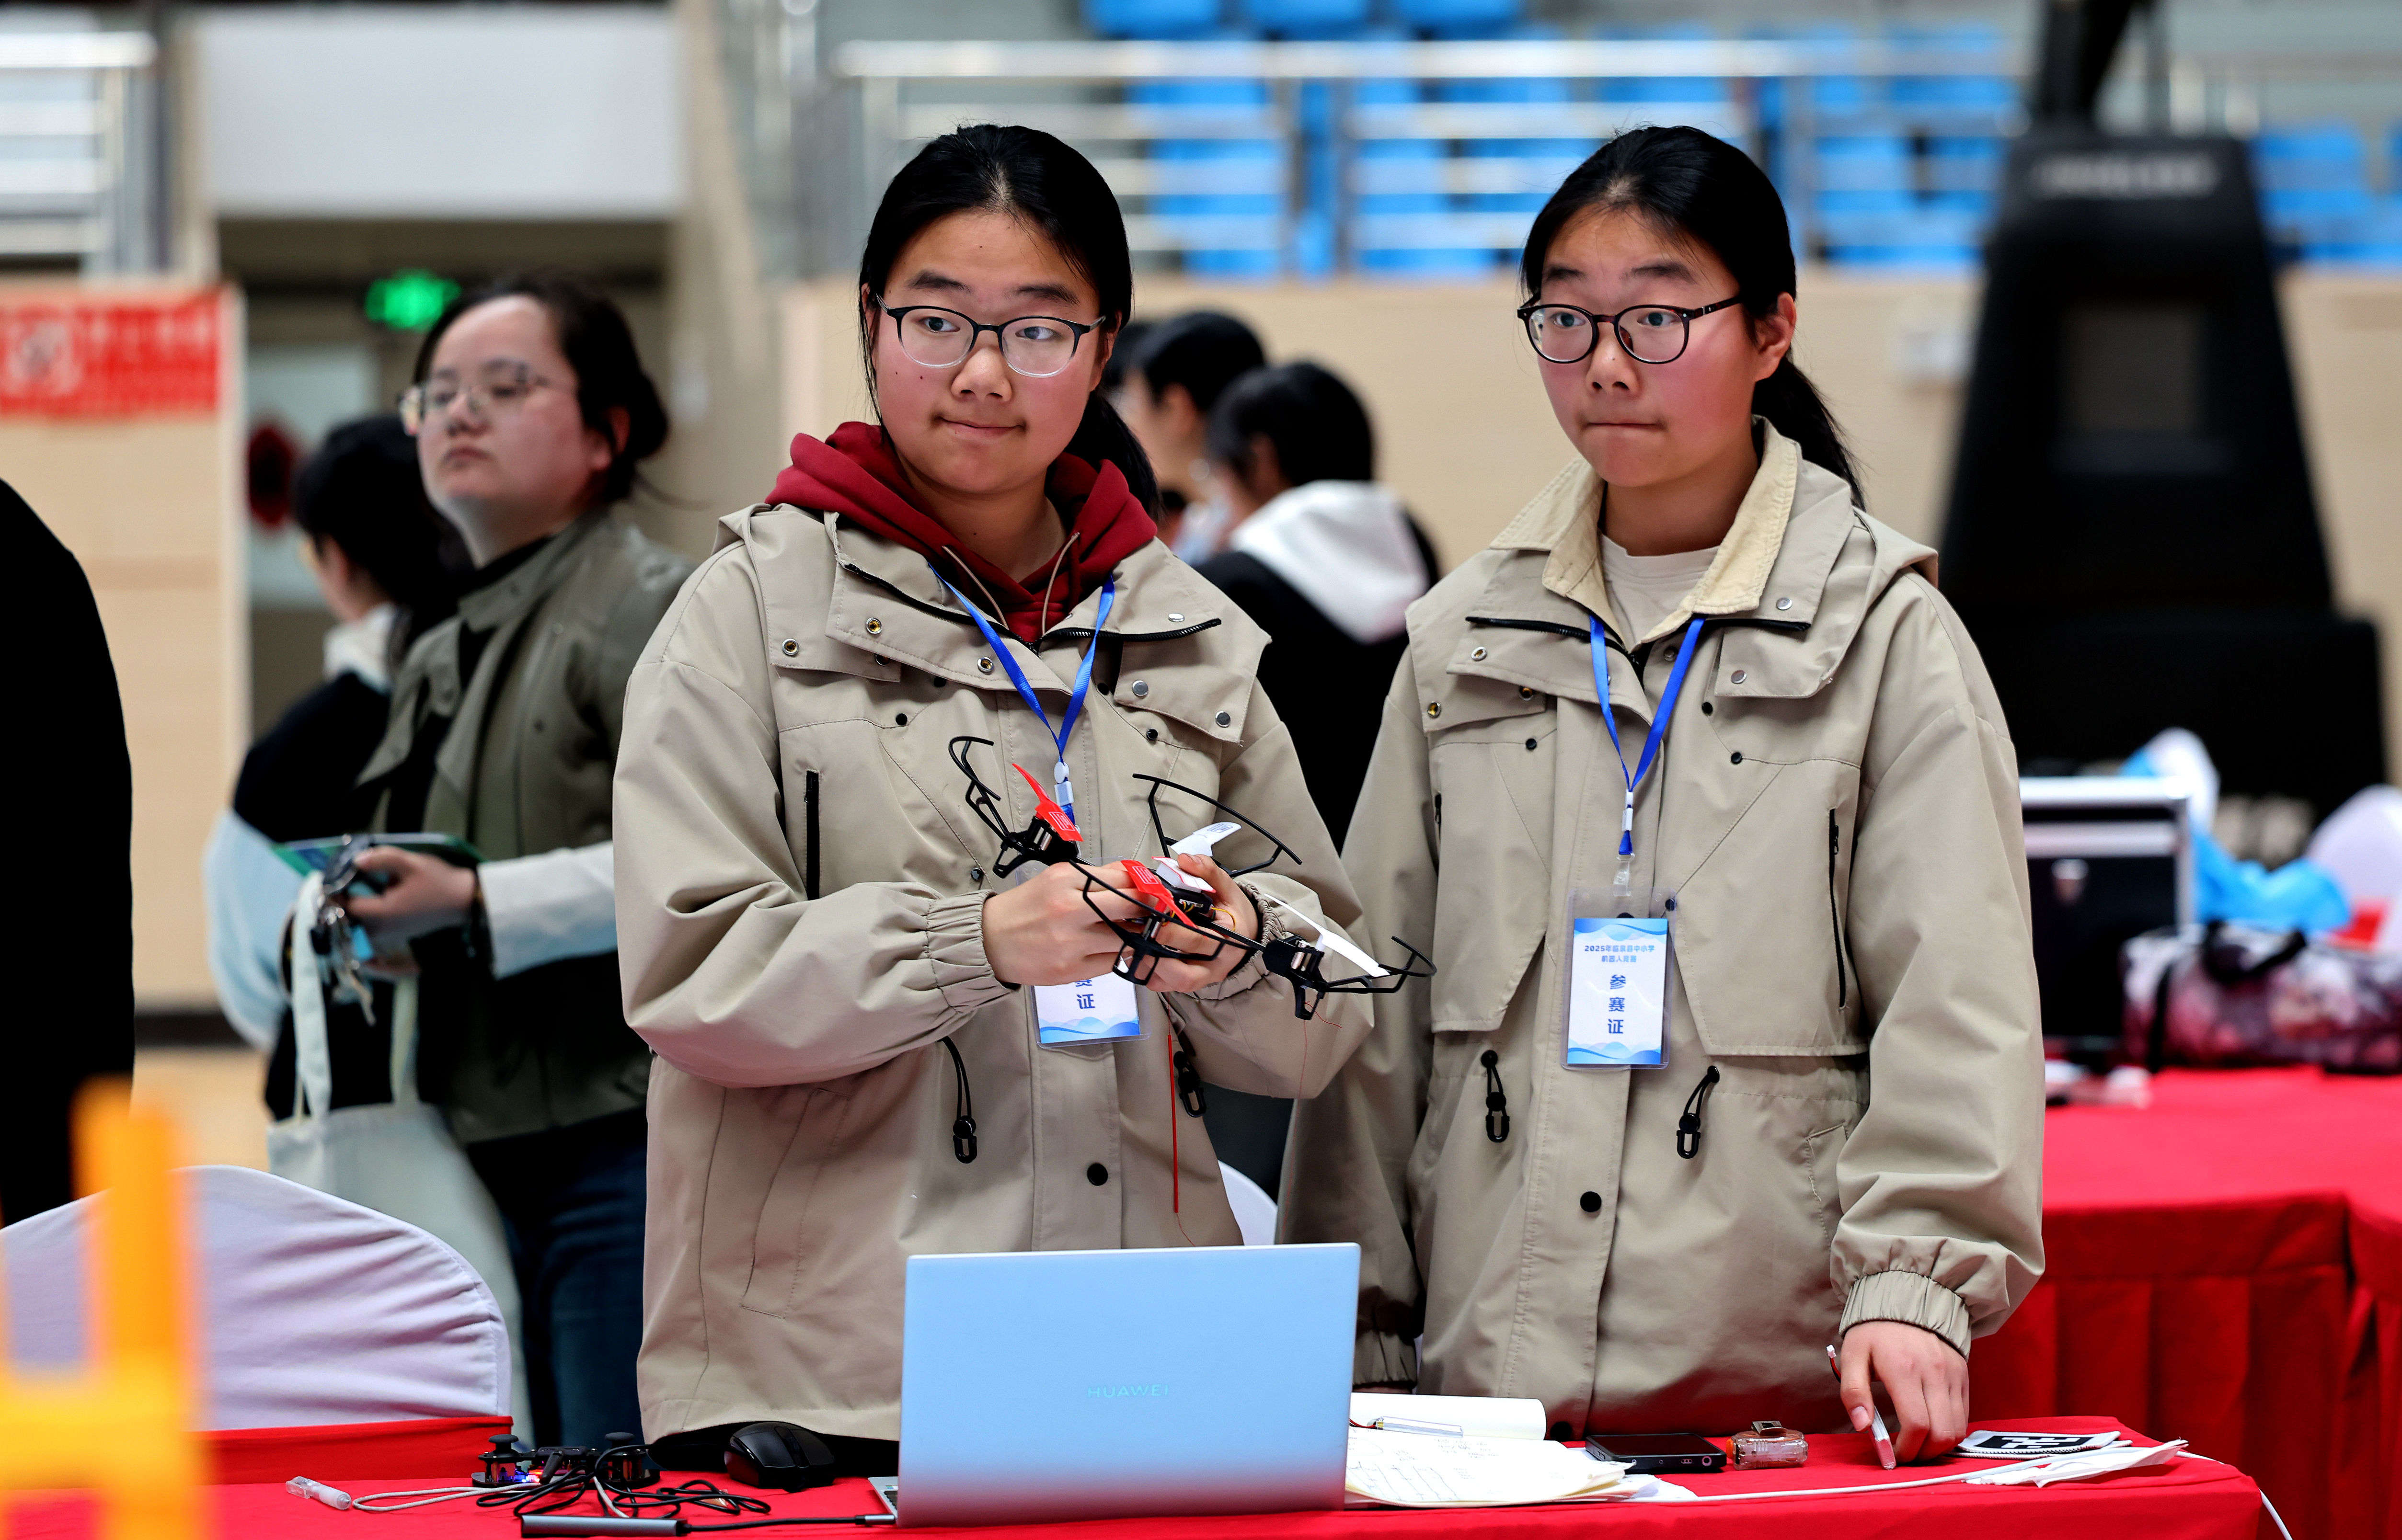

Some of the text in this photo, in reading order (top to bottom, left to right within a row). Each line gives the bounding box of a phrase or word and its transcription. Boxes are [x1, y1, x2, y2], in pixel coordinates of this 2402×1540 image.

[1608, 974, 1626, 1034] 参赛证
[1088, 1384, 1169, 1398] HUAWEI
